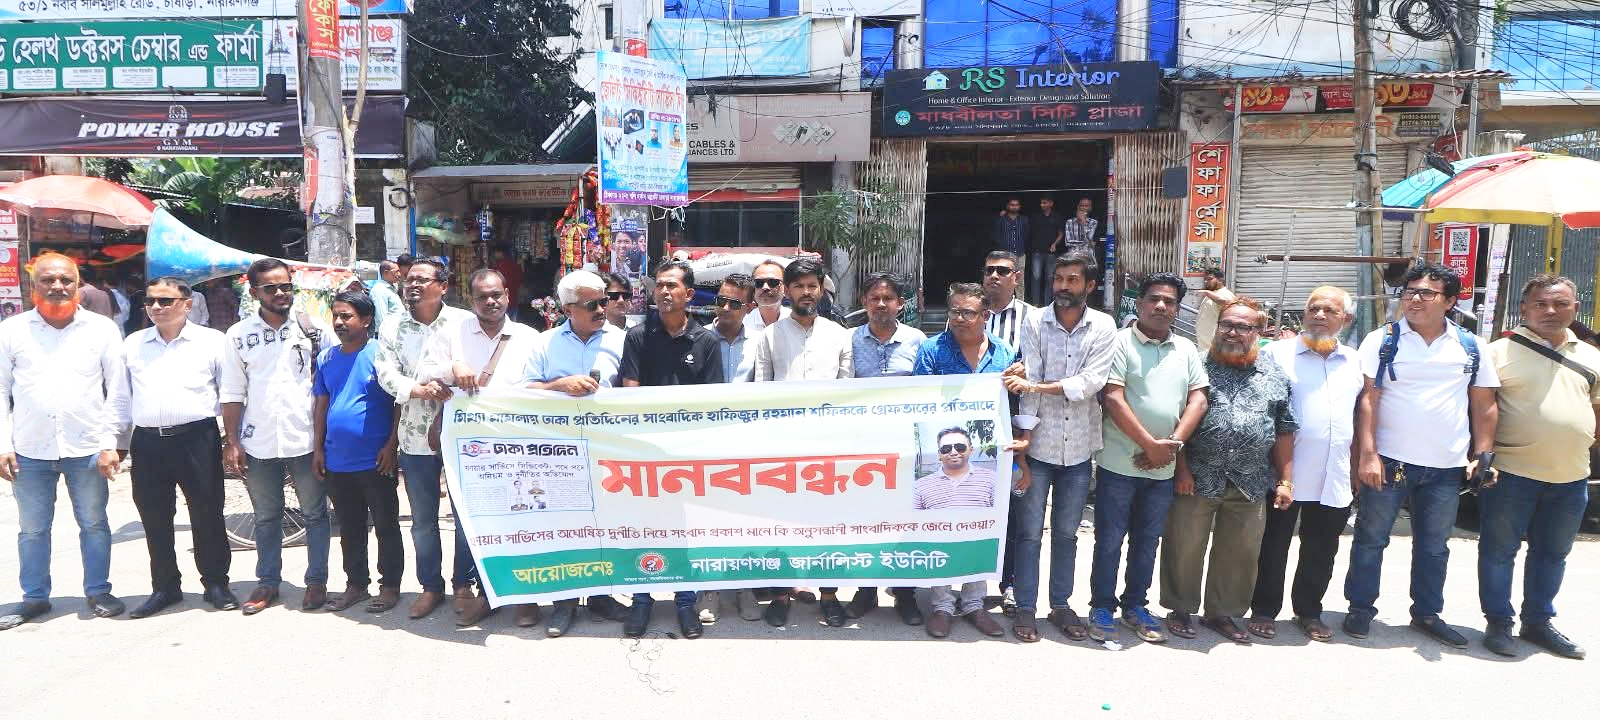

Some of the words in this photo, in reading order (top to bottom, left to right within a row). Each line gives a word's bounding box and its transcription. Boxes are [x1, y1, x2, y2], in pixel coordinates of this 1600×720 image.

[12, 33, 61, 65] হেলথ
[65, 25, 126, 63] ডক্টরস
[131, 33, 182, 62] চেম্বার
[214, 23, 260, 62] ফার্মা
[959, 66, 1006, 93] RS
[1015, 65, 1121, 89] Interior
[928, 97, 950, 105] Home
[957, 96, 977, 104] Office
[916, 105, 1021, 123] মাধবীলতা
[1031, 103, 1076, 121] সিটি
[1087, 103, 1145, 120] প্লাজা
[77, 122, 180, 138] POWER
[185, 121, 284, 137] HOUSE
[689, 140, 727, 149] CABLES
[730, 140, 736, 149] &
[720, 148, 737, 156] LTD.
[454, 409, 486, 424] মিথ্যা
[542, 414, 570, 426] ঢাকা
[573, 412, 640, 426] প্রতিদিনের
[643, 410, 704, 424] সাংবাদিক
[707, 408, 759, 423] হাফিজুর
[762, 408, 806, 419] রহমান
[809, 403, 868, 417] শফিককে
[871, 403, 937, 415] গ্রেফতারের
[941, 398, 996, 413] প্রতিবাদে
[493, 443, 525, 455] ঢাকা
[526, 443, 579, 457] প্রতিদিন
[598, 453, 900, 497] মানববন্ধন
[504, 528, 555, 545] সার্ভিসের
[557, 525, 606, 539] অঘোষিত
[608, 524, 641, 540] দুর্নীতি
[643, 527, 668, 538] নিয়ে
[671, 528, 706, 538] সংবাদ
[710, 527, 743, 538] প্রকাশ
[746, 527, 771, 537] মানে
[774, 524, 789, 536] কি
[793, 523, 847, 539] অনুসন্ধানী
[850, 521, 919, 535] সাংবাদিককে
[922, 521, 953, 532] জেলে
[955, 519, 996, 532] দেওয়া?
[512, 560, 614, 585] আয়োজনেঃ
[689, 555, 781, 573] নারায়ণগঞ্জ
[787, 550, 876, 571] জার্নালিস্ট
[879, 549, 950, 570] ইউনিটি
